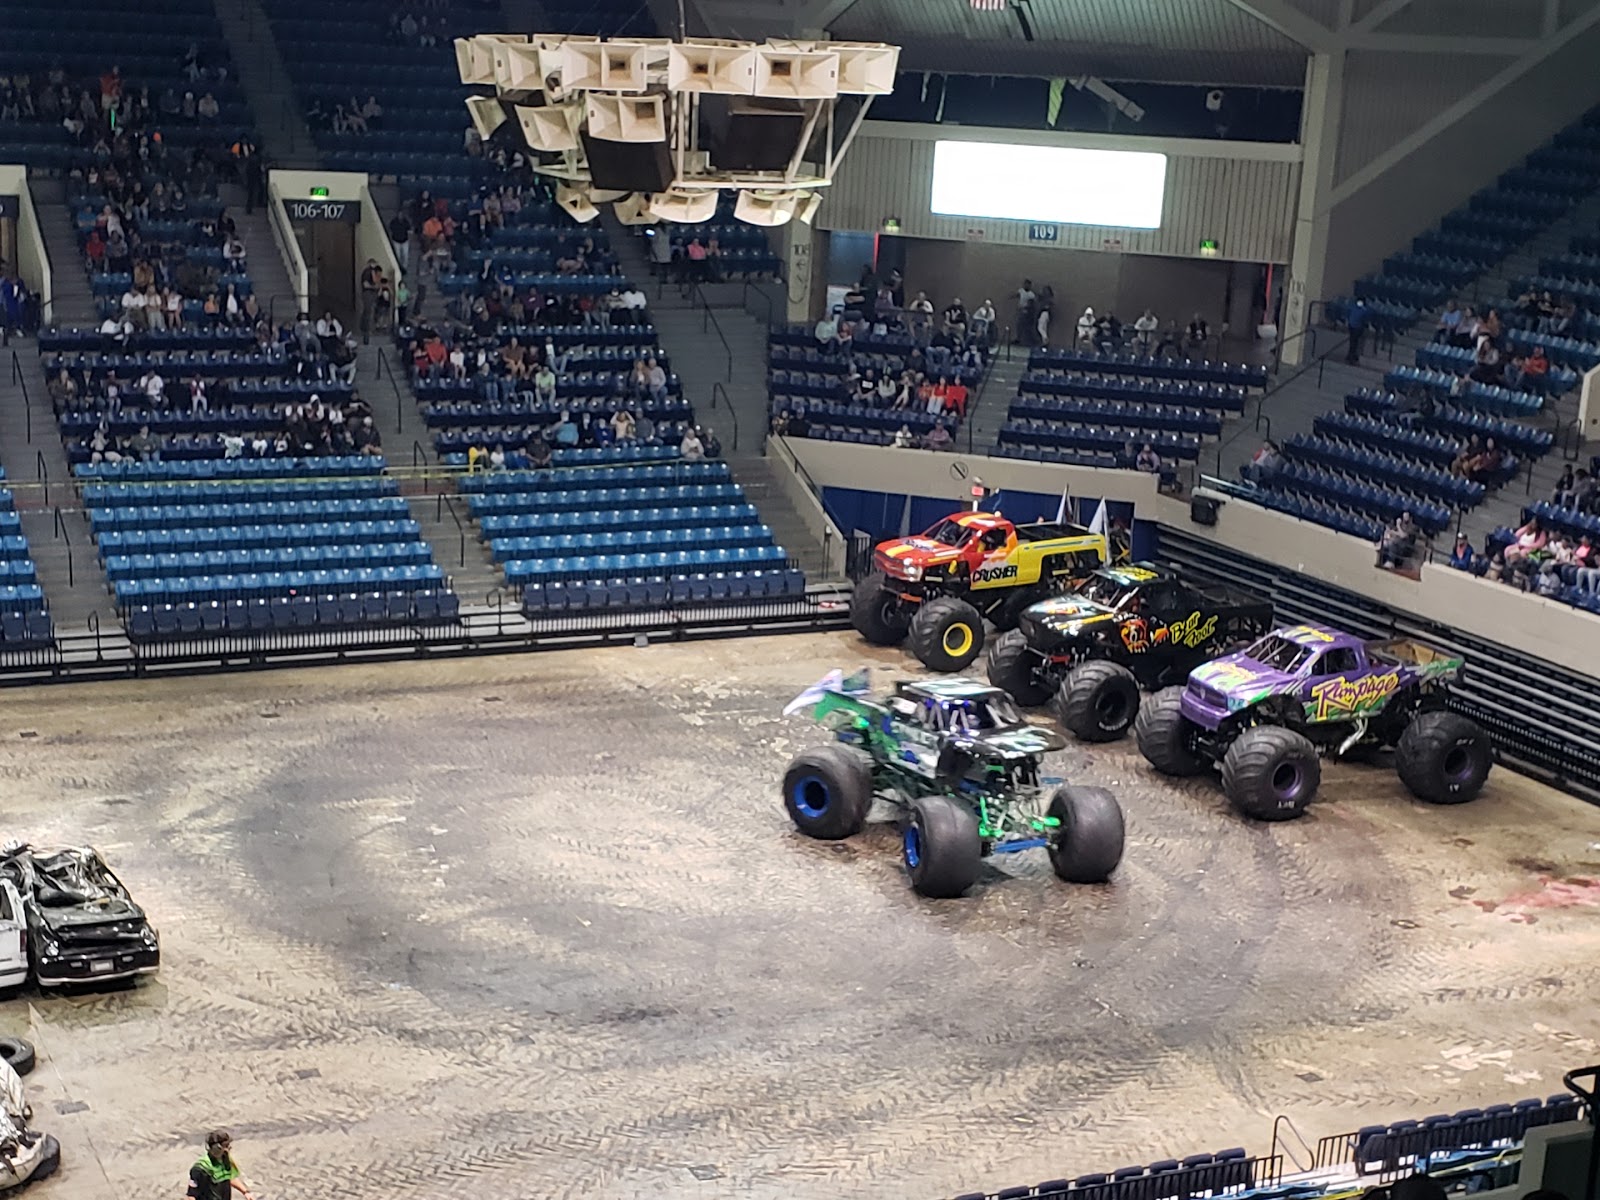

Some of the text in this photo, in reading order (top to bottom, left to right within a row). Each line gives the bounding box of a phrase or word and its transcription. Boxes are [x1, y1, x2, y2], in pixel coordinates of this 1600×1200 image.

[292, 204, 344, 218] 106-107
[1033, 226, 1055, 239] 109
[973, 565, 1018, 582] CRUSHER
[1311, 672, 1399, 722] Rampage
